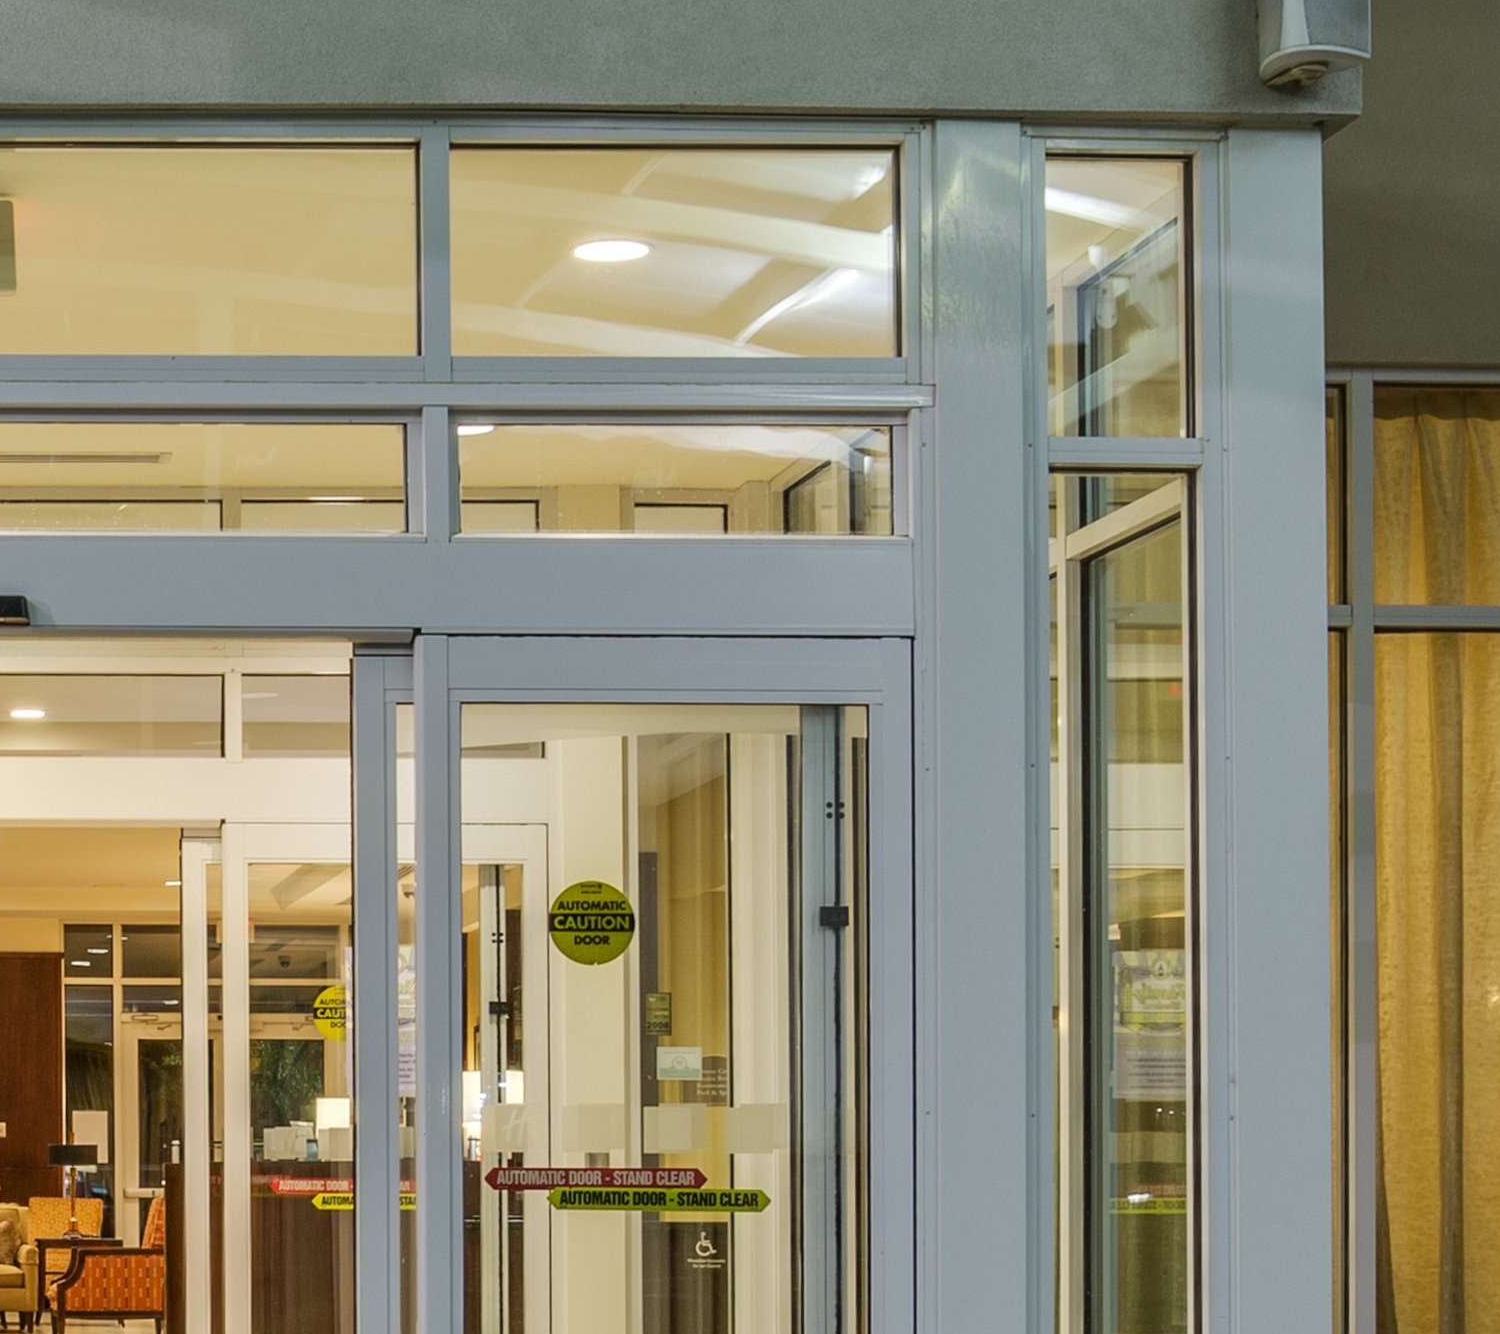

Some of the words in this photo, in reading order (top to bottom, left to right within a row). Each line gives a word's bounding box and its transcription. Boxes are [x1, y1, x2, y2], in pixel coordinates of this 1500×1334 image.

[557, 900, 626, 911] AUTOMATIC
[554, 916, 630, 929] CAUTION
[574, 935, 610, 945] DOOR
[496, 1170, 565, 1185] AUTOMATIC
[568, 1170, 602, 1185] DOOR
[613, 1171, 653, 1185] STAND
[656, 1171, 695, 1185] CLEAR
[278, 1180, 325, 1191] AUTOMATIC
[326, 1180, 349, 1191] DOOR
[560, 1191, 630, 1205] AUTOMATIC
[633, 1192, 667, 1205] DOOR
[677, 1192, 716, 1206] STAND
[720, 1193, 759, 1206] CLEAR
